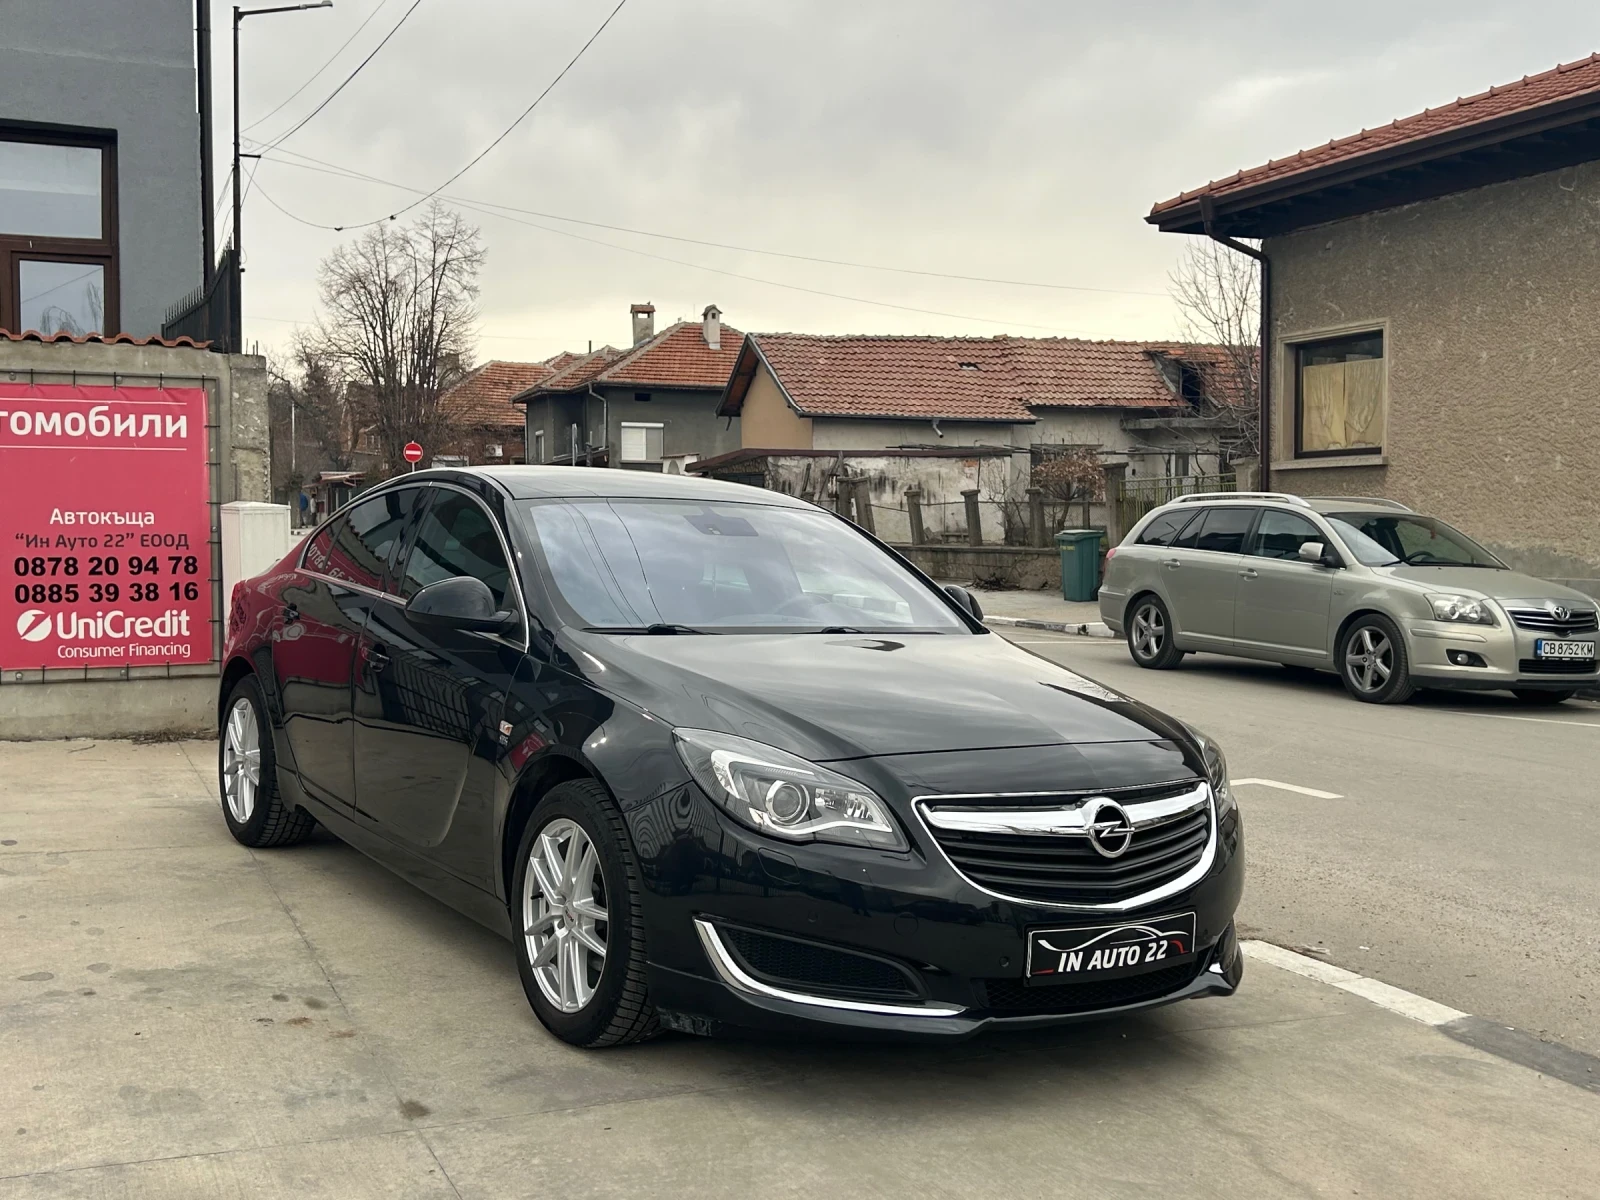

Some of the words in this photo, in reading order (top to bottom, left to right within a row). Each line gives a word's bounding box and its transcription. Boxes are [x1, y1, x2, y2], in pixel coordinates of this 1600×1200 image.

[50, 508, 155, 527] Автокъща
[55, 534, 98, 551] Ауто
[140, 533, 189, 550] ЕООД
[14, 556, 79, 577] 0878
[88, 557, 119, 577] 20
[128, 557, 160, 576] 94
[167, 556, 199, 575] 78
[14, 583, 80, 604] 0885
[88, 583, 120, 603] 39
[128, 583, 160, 602] 38
[169, 582, 199, 602] 16
[56, 609, 190, 640] UniCredit
[57, 645, 126, 658] Consumer
[129, 643, 191, 657] Financing
[1557, 642, 1579, 656] 8752
[1057, 952, 1083, 973] IN
[1087, 946, 1141, 970] AUTO
[1144, 940, 1168, 963] 22
